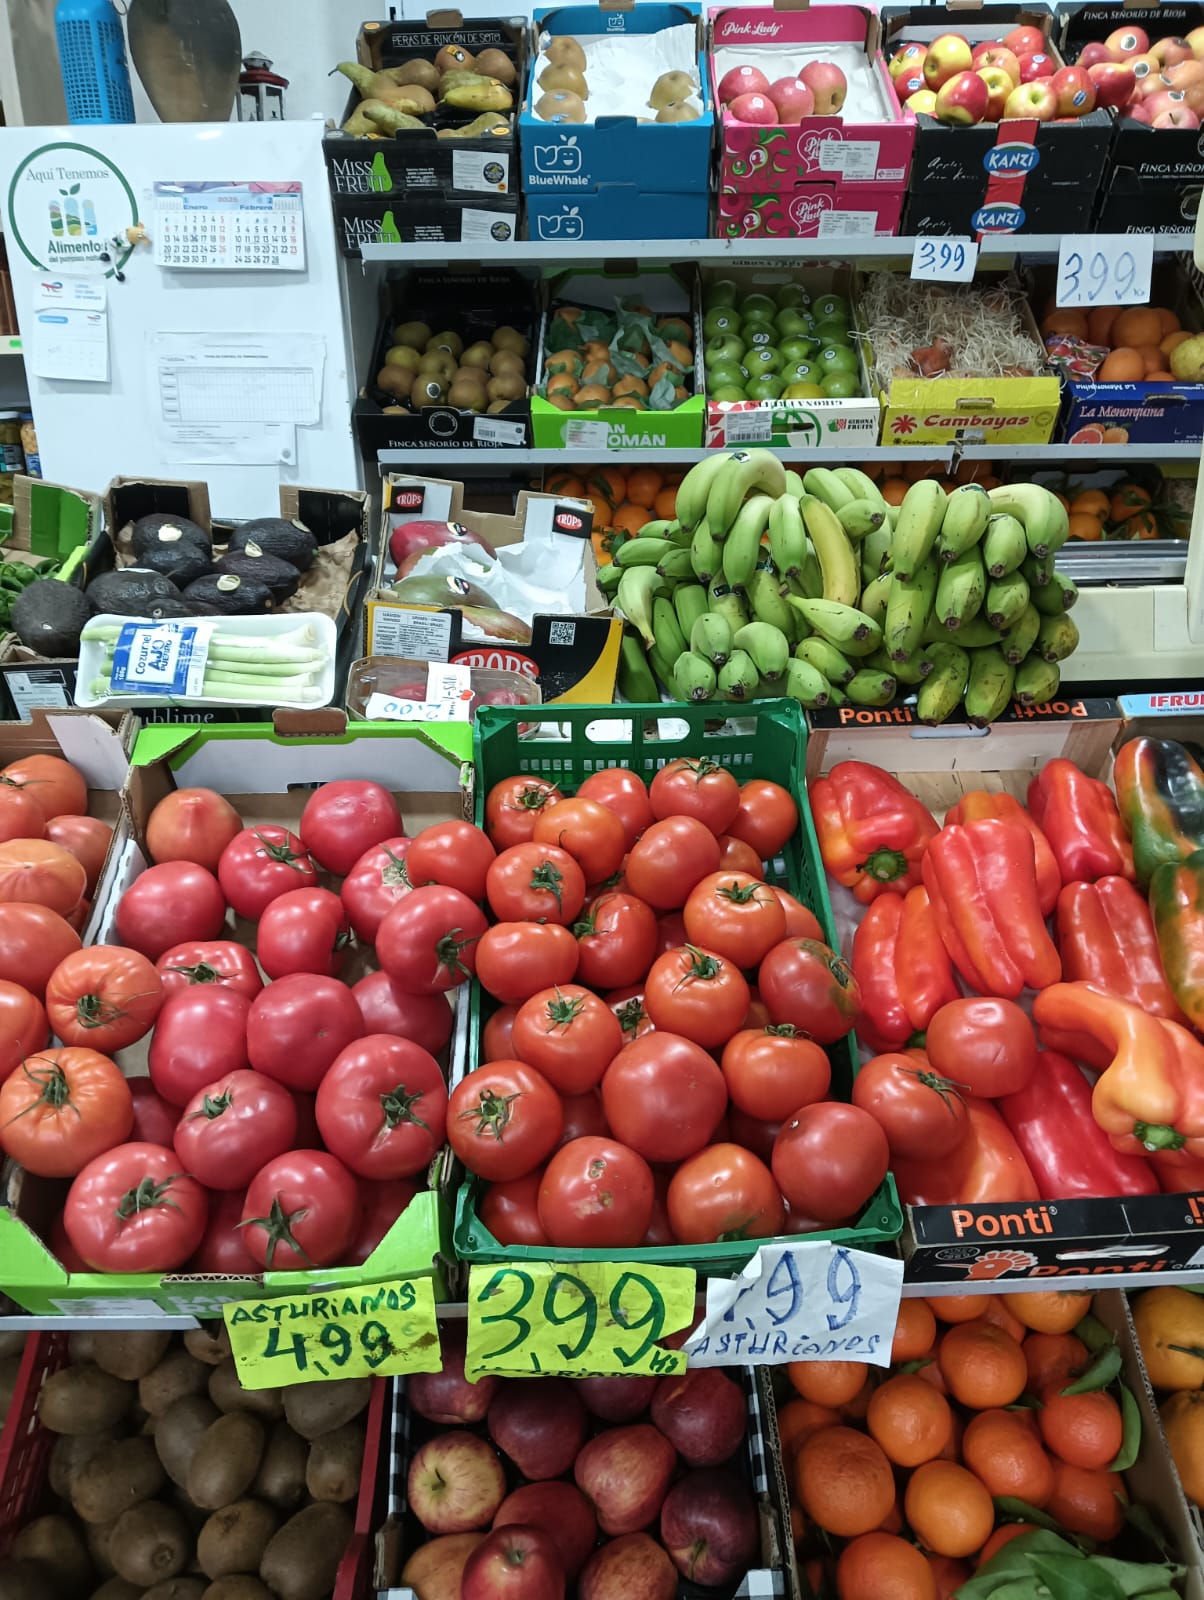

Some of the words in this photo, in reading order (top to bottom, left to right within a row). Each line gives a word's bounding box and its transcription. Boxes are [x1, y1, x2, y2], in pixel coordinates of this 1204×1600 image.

[1083, 11, 1108, 20] FINCA
[722, 22, 751, 36] Pink
[752, 22, 780, 37] Lady
[392, 35, 420, 47] PERAS
[420, 35, 432, 45] DE
[467, 33, 478, 43] DE
[56, 168, 109, 180] Tenemos
[332, 159, 372, 175] MISS
[1140, 163, 1170, 173] FINCA
[335, 175, 386, 192] FRUIT
[529, 175, 589, 185] BlueWhale
[343, 217, 382, 234] MISS
[1126, 225, 1155, 233] FINCA
[919, 242, 965, 272] 3,99
[1060, 251, 1136, 303] 3,99
[1080, 406, 1096, 417] La
[1097, 406, 1165, 421] Menorquina
[924, 414, 1029, 430] Cambayas
[388, 440, 418, 448] FINCA
[419, 439, 460, 448] SEÑORÍO
[608, 431, 666, 446] OMÁN
[397, 493, 422, 505] TROPS
[556, 514, 582, 528] TROPS
[148, 640, 165, 671] AJO
[839, 707, 913, 724] Ponti
[1014, 701, 1089, 719] Ponti
[951, 1206, 1054, 1238] Ponti
[477, 1268, 666, 1372] 3,99
[264, 1321, 392, 1376] 4,99
